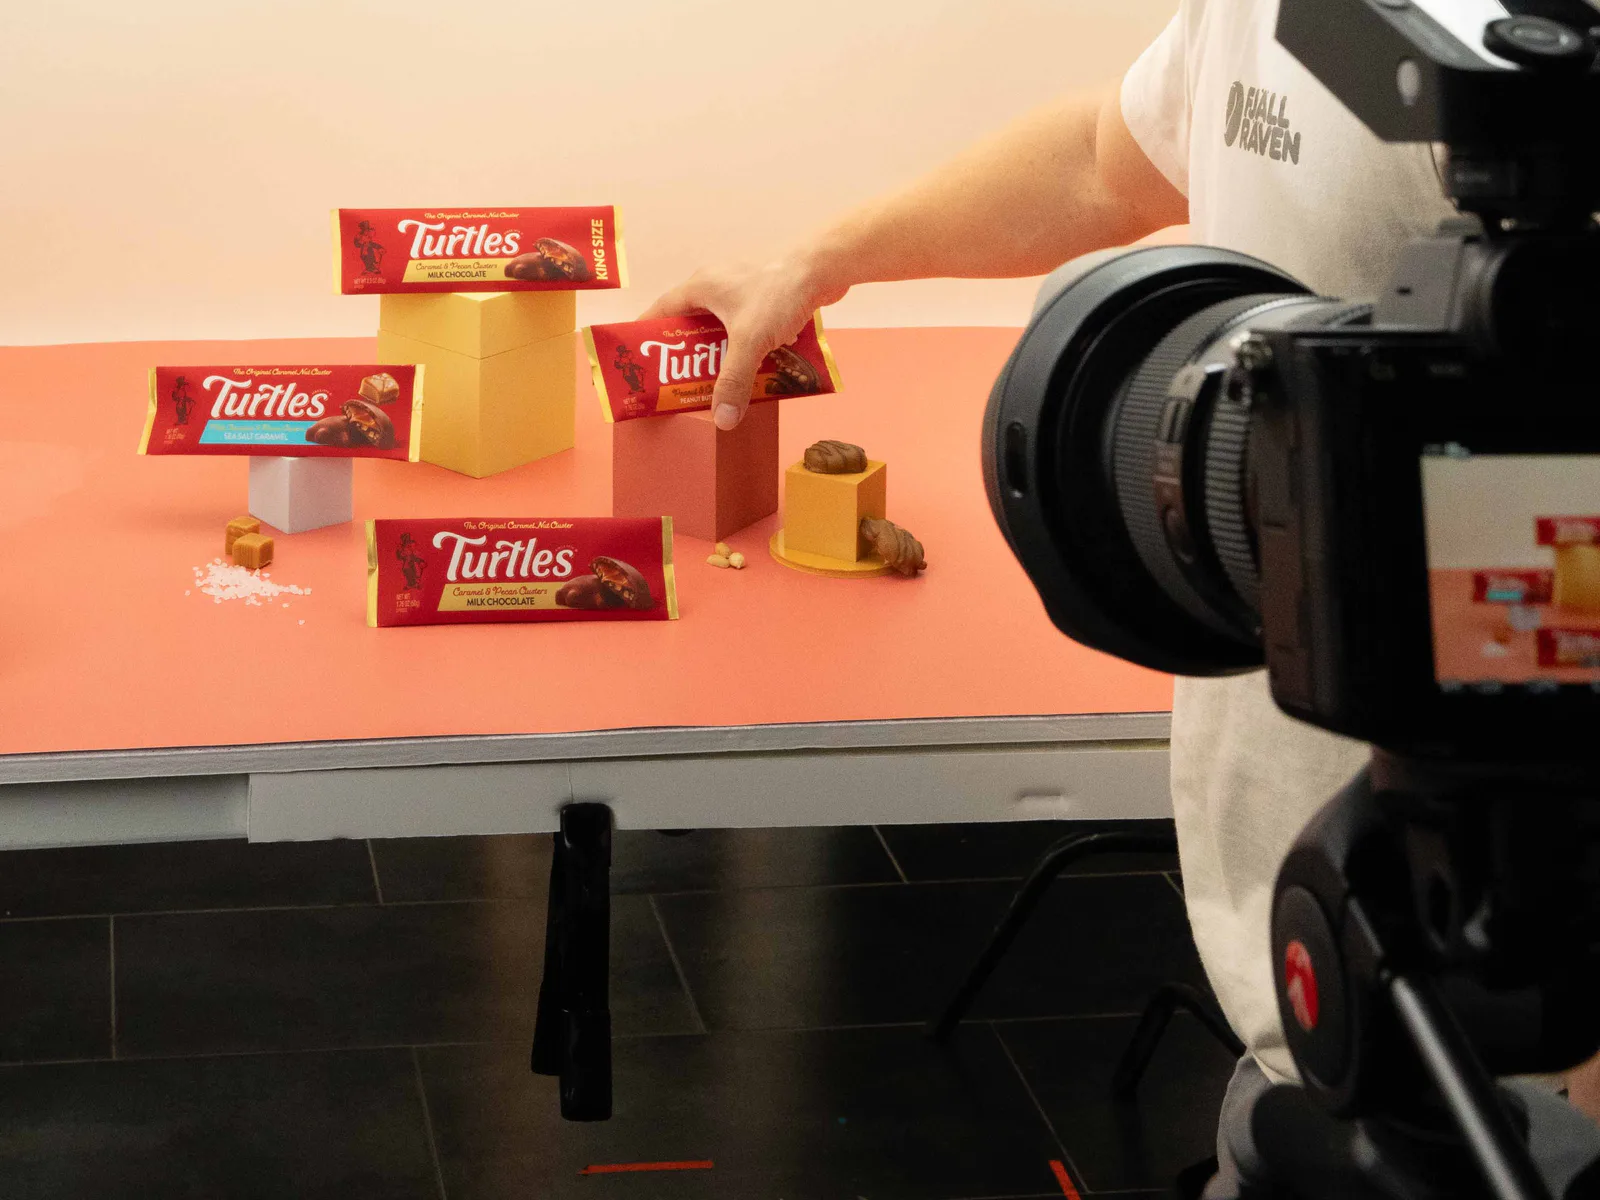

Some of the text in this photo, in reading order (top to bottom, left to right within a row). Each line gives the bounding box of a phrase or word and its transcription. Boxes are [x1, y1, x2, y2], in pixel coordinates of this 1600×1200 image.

[437, 212, 461, 220] Original
[397, 219, 521, 259] Turtles
[591, 218, 609, 280] KING SIZE
[415, 261, 498, 270] Caramel & Pecan Clusters
[427, 270, 487, 279] MILK CHOCOLATE
[675, 328, 700, 337] Original
[640, 338, 728, 384] Turtl
[246, 368, 272, 377] Original
[310, 368, 332, 376] Cluster
[202, 375, 329, 418] Turtles
[223, 432, 288, 441] SEA SALT CARAMEL
[463, 521, 574, 531] The Original Caramel Nut Cluster
[432, 531, 574, 581] Turtles
[452, 585, 548, 596] Caramel & Pecan Clusters
[466, 597, 535, 606] MILK CHOCOLATE
